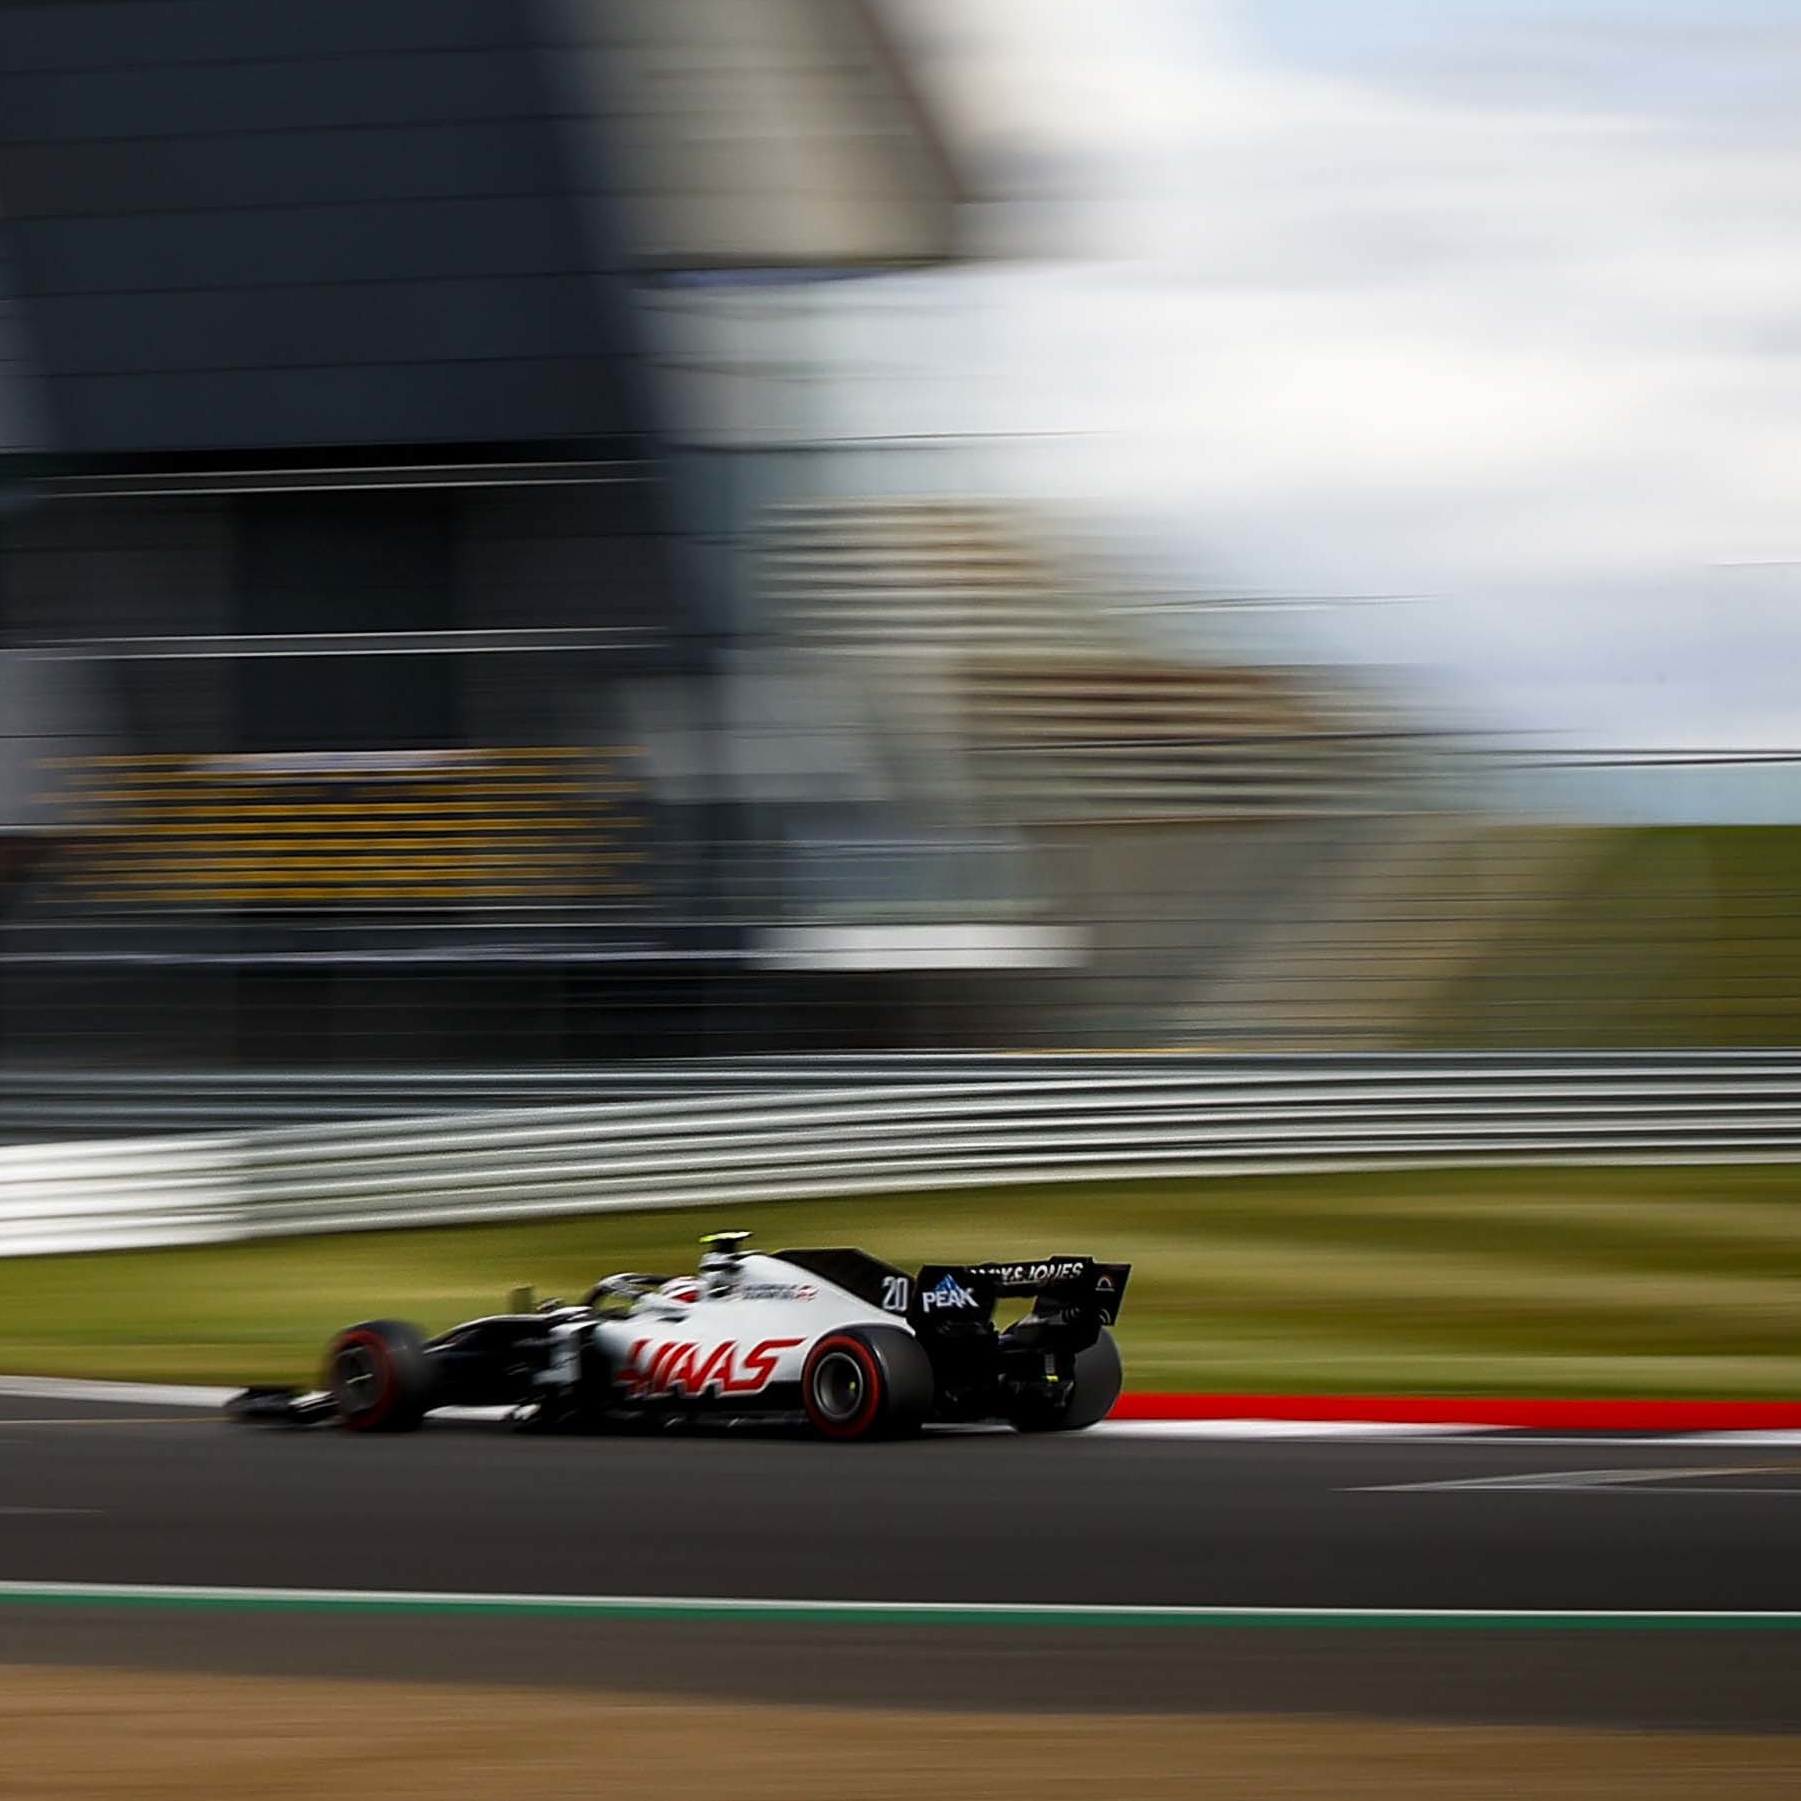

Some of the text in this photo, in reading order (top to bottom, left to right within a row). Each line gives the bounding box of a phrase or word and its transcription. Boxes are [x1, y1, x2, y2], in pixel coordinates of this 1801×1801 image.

[882, 1275, 909, 1312] 20
[922, 1287, 979, 1313] PEAK
[616, 1336, 807, 1396] HAAS
